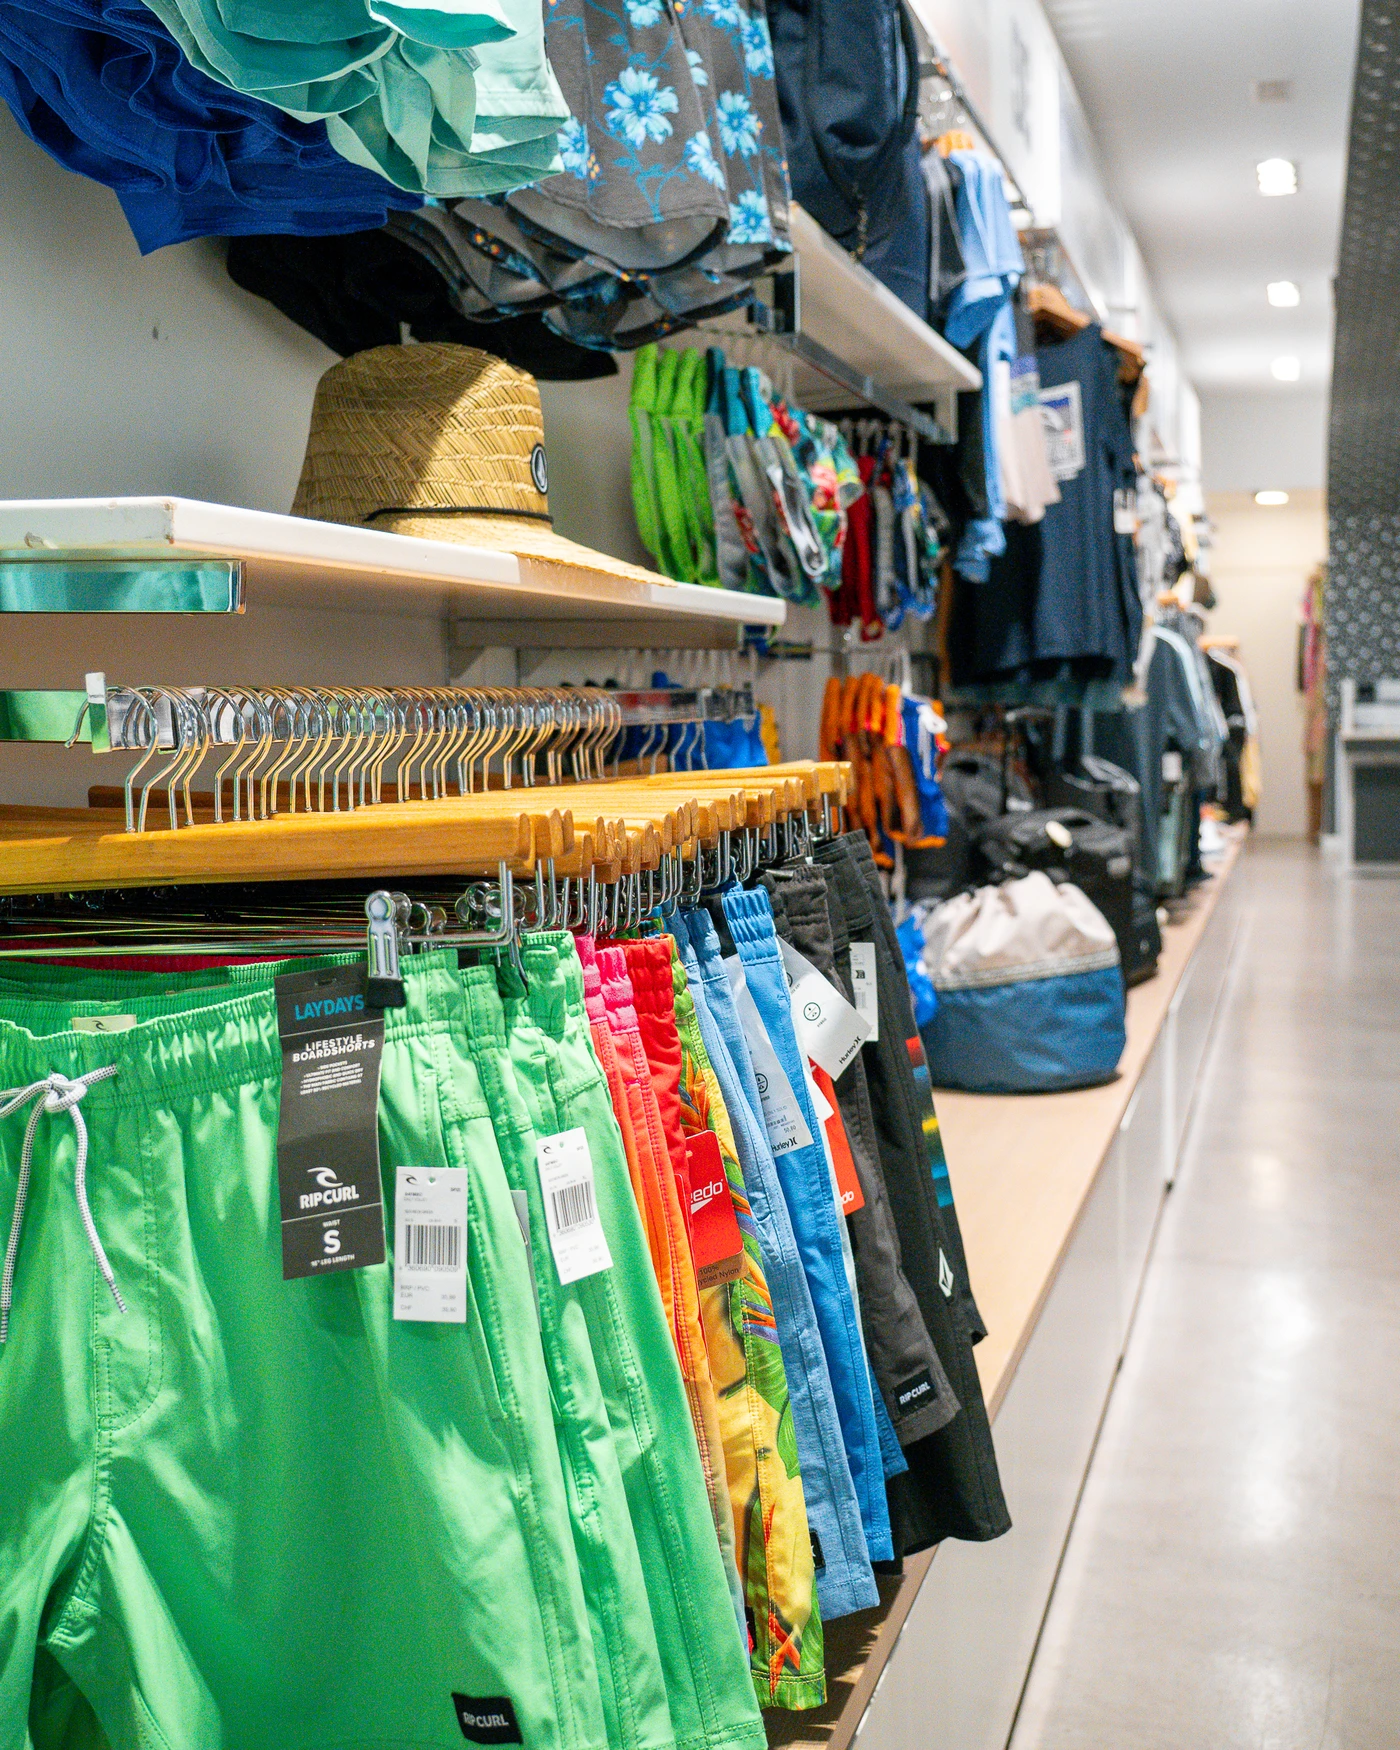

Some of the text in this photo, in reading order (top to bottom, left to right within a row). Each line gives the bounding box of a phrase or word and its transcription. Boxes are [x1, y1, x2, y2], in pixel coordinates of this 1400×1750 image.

[294, 994, 365, 1021] LAYDAYS
[292, 1039, 376, 1062] BOARDSHORTS
[305, 1033, 363, 1052] LIFESTYLE
[838, 1043, 857, 1065] Hurley
[771, 1139, 790, 1153] Hurley
[691, 1181, 723, 1203] edo
[323, 1229, 341, 1255] S
[697, 1267, 740, 1287] ycled Nylon
